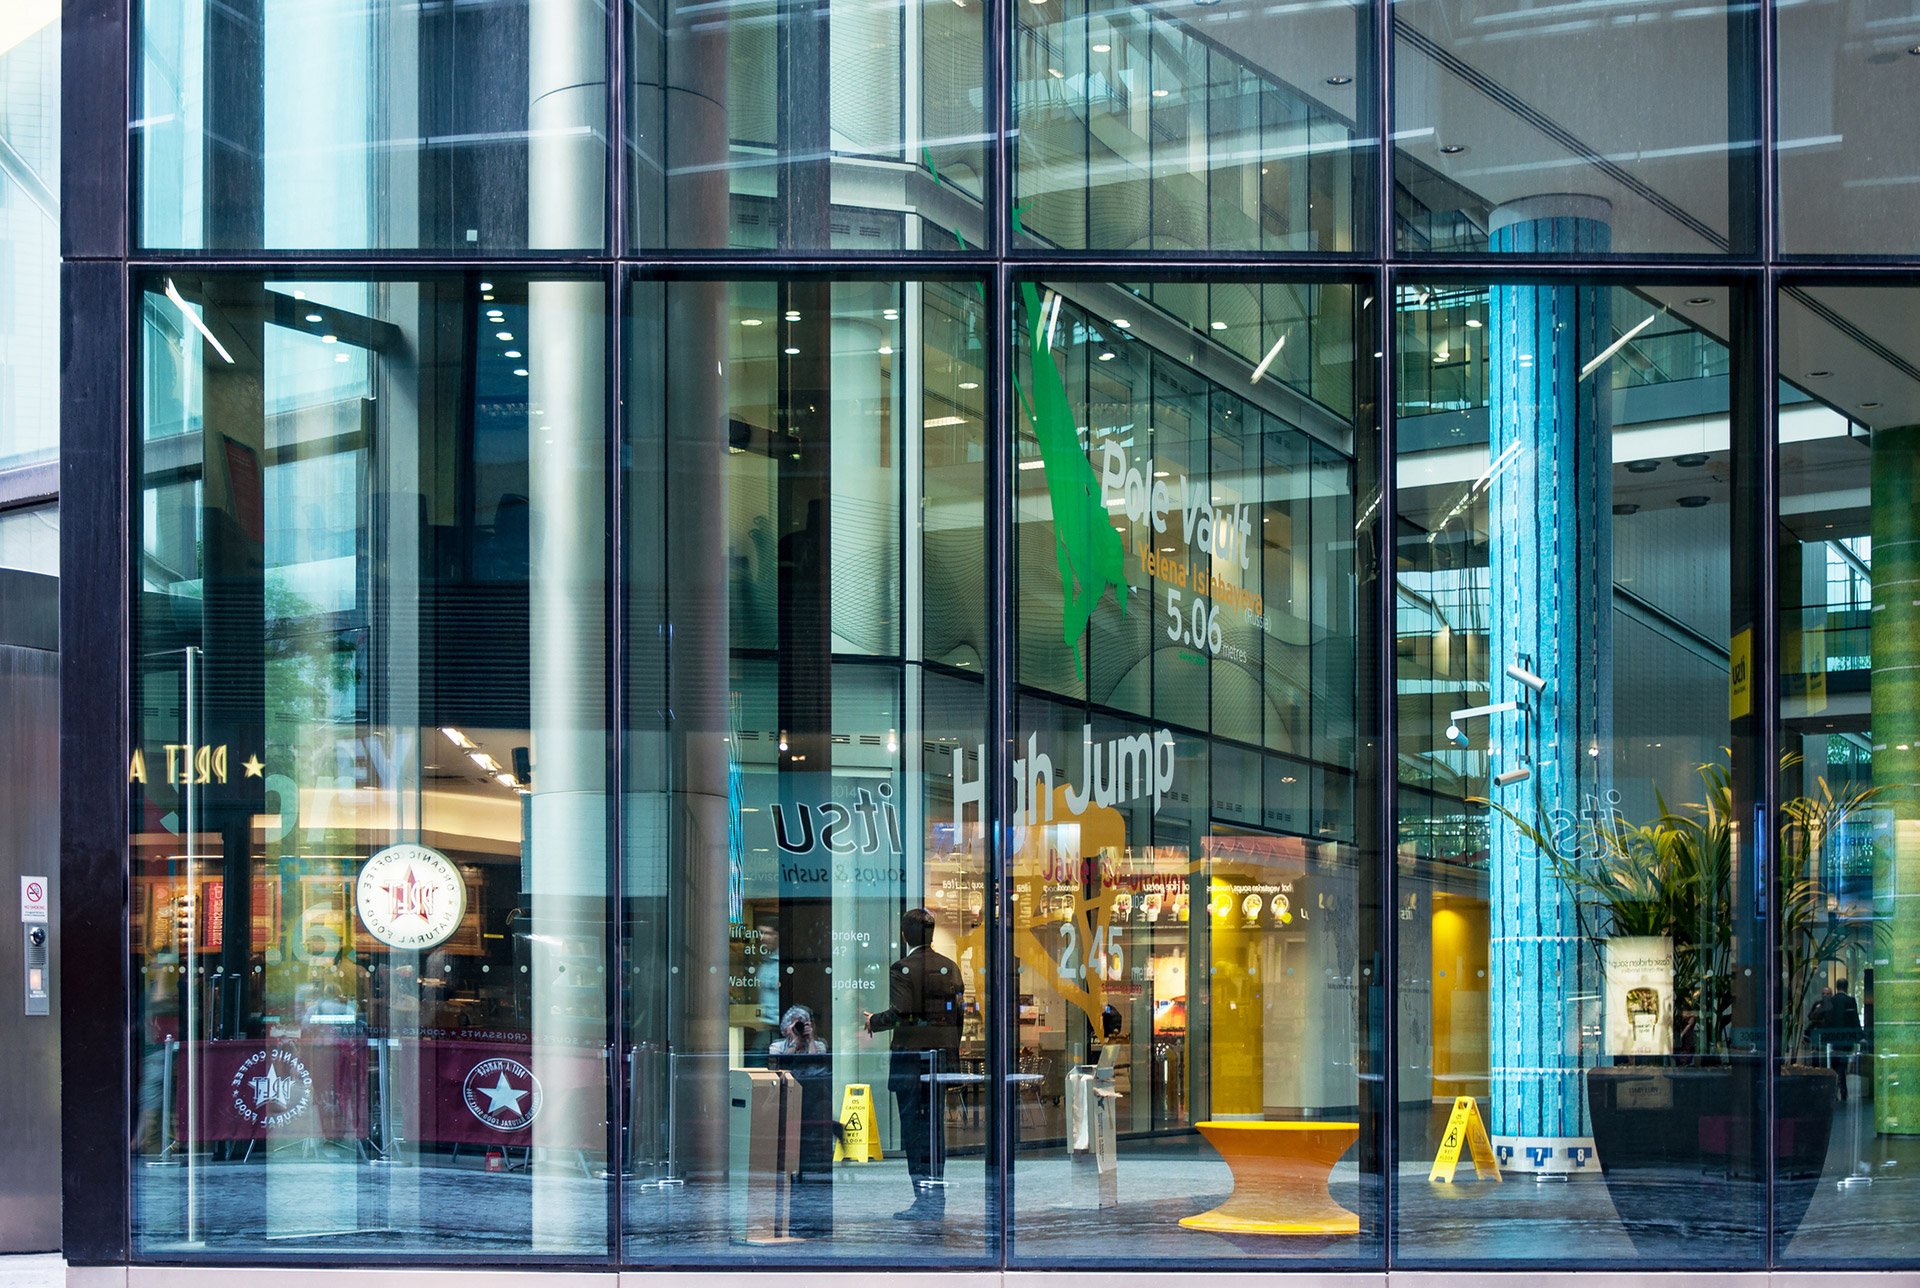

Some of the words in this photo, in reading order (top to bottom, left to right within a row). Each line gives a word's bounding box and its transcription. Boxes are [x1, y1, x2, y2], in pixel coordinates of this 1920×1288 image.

[1101, 438, 1169, 534] Pole
[1180, 474, 1252, 570] Vault
[1137, 541, 1187, 588] Yelena
[1193, 563, 1264, 619] Isinbayeva
[1167, 588, 1222, 654] 5.06
[1244, 607, 1272, 633] (Russia)
[1223, 642, 1248, 664] metres
[953, 731, 1053, 854] Hgh
[1064, 724, 1175, 816] Jump
[745, 929, 765, 941] any
[831, 929, 871, 942] broken
[744, 945, 756, 955] at
[1059, 922, 1124, 981] 2.45
[728, 975, 761, 987] Watch
[831, 977, 876, 991] updates
[1501, 1147, 1507, 1161] 6
[1535, 1149, 1543, 1162] 7
[1576, 1149, 1585, 1162] 8
